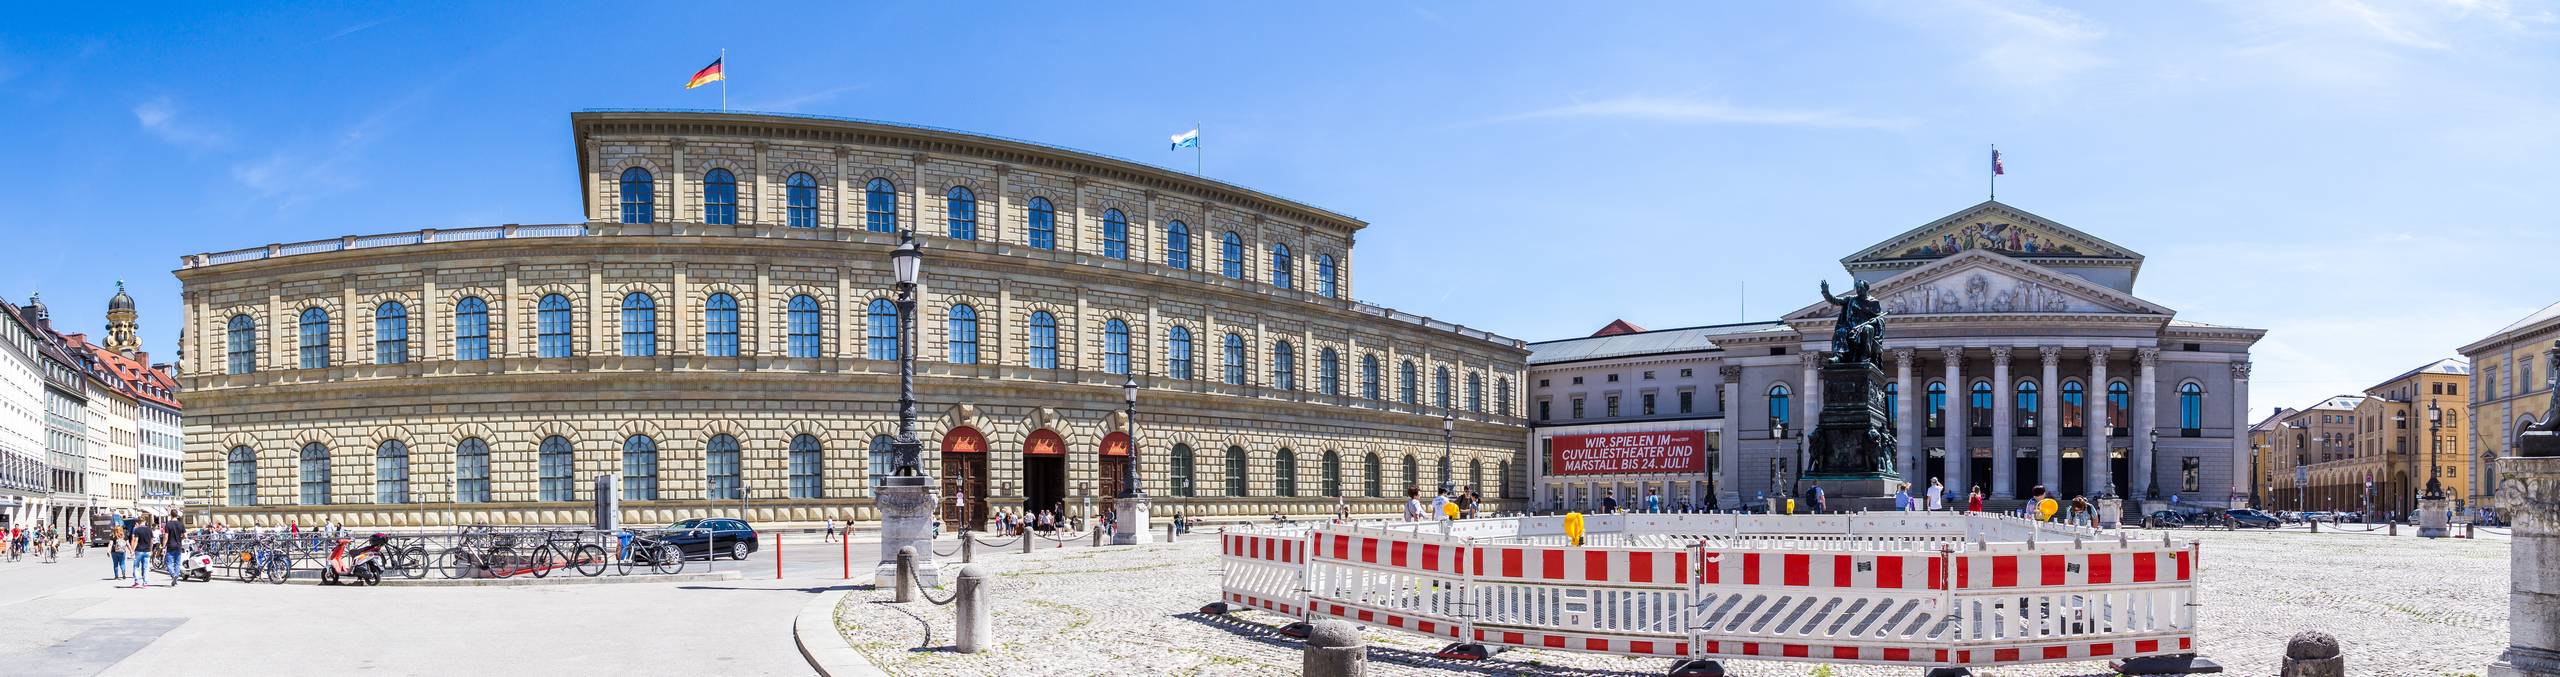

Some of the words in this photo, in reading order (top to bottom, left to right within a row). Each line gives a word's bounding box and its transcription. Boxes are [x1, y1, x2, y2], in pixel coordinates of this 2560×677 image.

[1585, 437, 1606, 448] WIR
[1609, 435, 1654, 447] SPIELEN
[1657, 434, 1671, 445] IM
[1562, 446, 1665, 460] CUVILLIÉSTHEATER
[1667, 446, 1693, 457] UND
[1565, 460, 1618, 471] MARSTALL
[1621, 459, 1639, 470] BIS
[1641, 458, 1658, 469] 24.
[1661, 457, 1690, 469] JULI!
